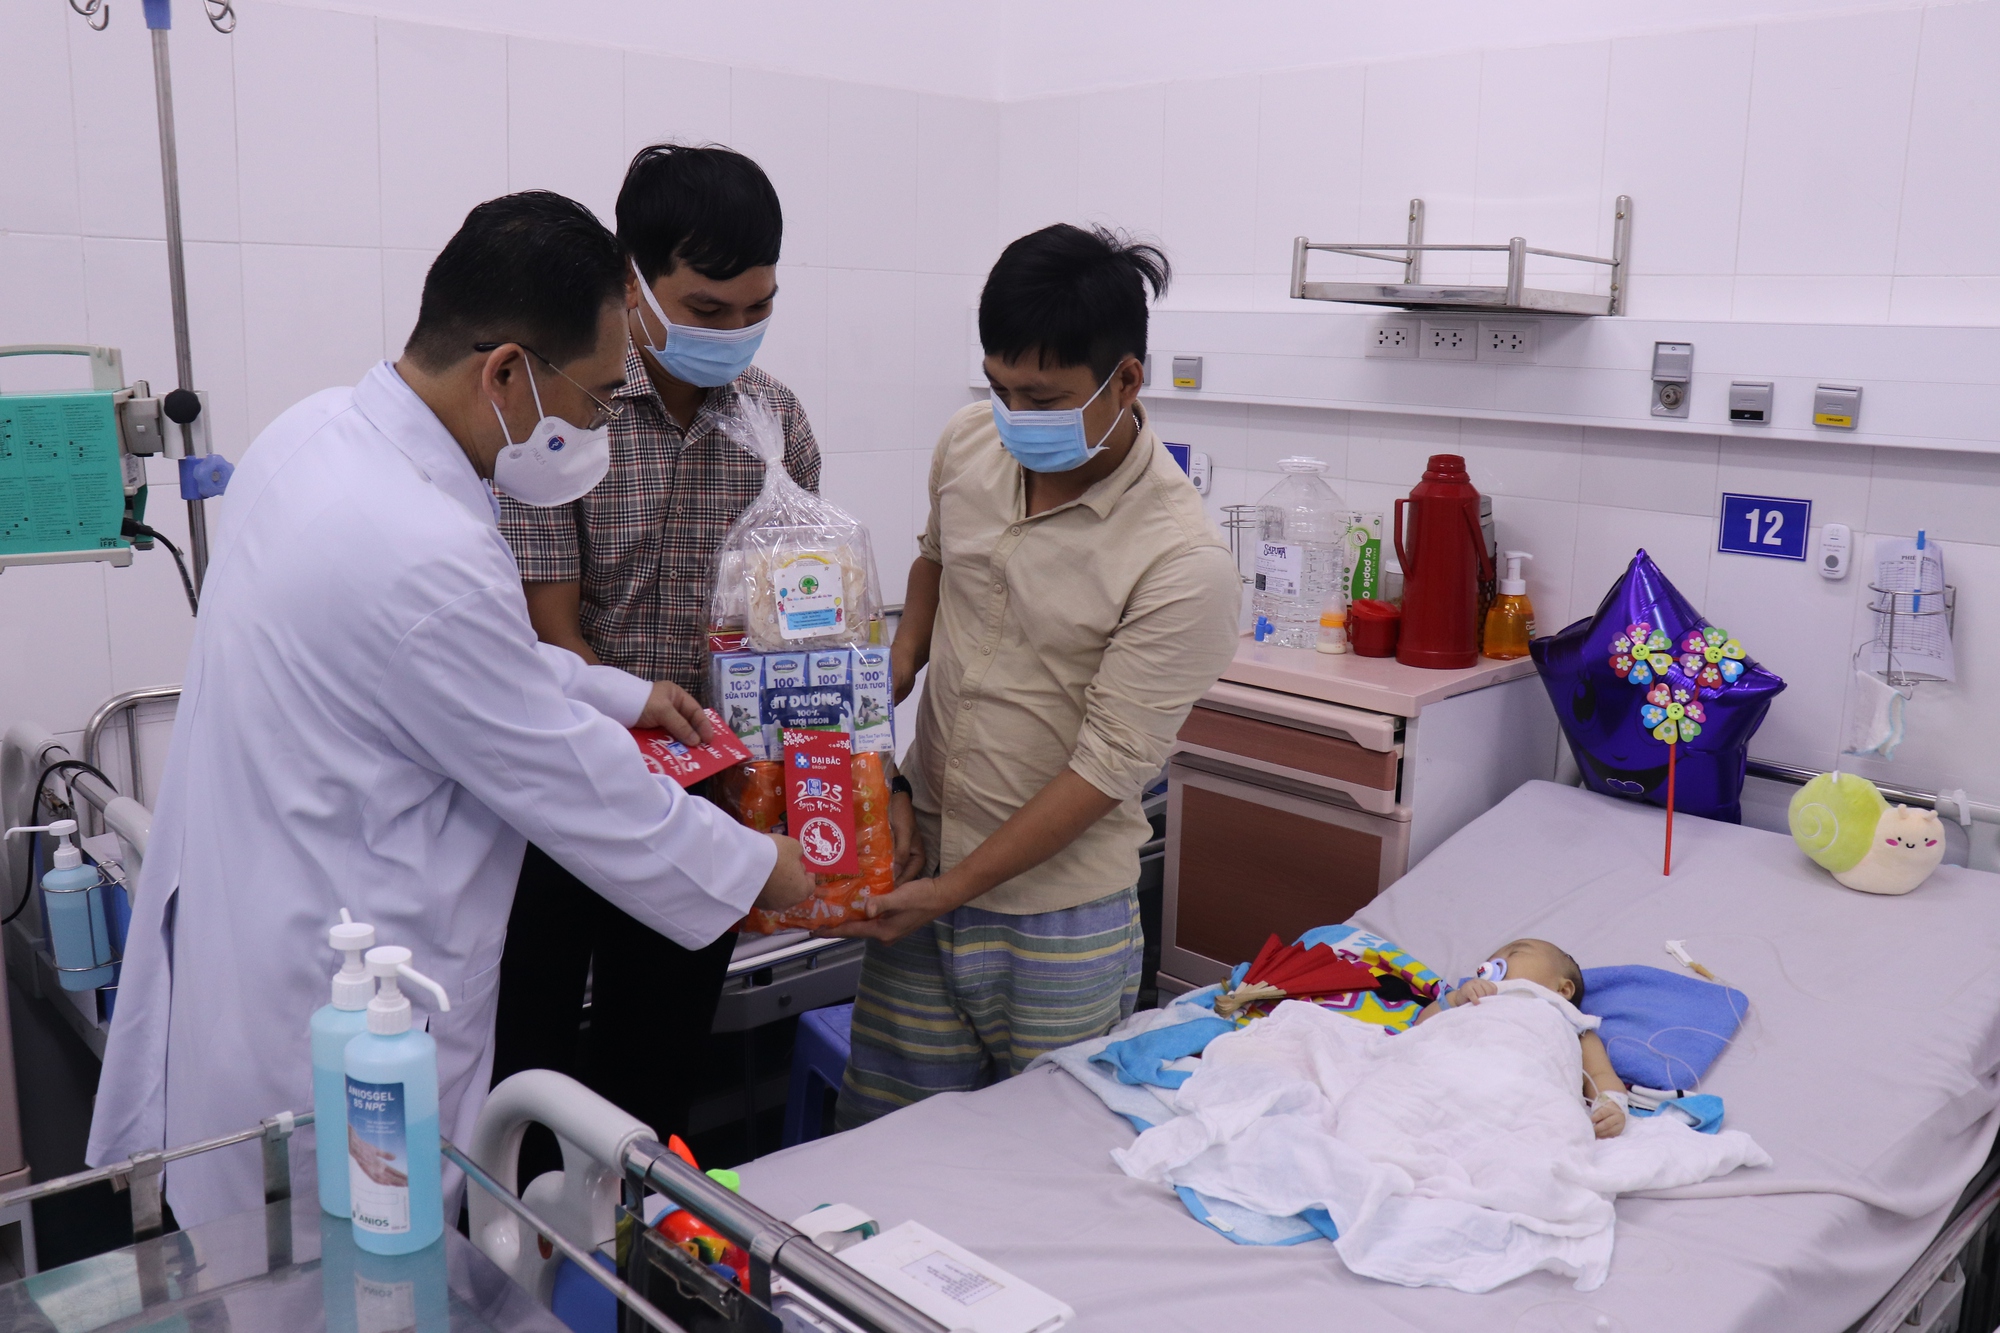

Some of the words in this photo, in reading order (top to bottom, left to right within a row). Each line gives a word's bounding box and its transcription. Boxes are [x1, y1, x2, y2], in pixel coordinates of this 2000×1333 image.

[1745, 508, 1784, 546] 12
[1365, 547, 1373, 558] Dr.
[788, 691, 842, 708] ĐƯỜNG
[797, 709, 820, 717] 100%
[808, 717, 830, 725] NGON
[811, 756, 825, 765] ĐẠI
[826, 755, 841, 765] BẮC
[348, 1085, 395, 1102] ANIOSGEL
[353, 1098, 363, 1109] 85
[365, 1101, 386, 1112] NPC
[359, 1214, 389, 1228] ANIOS
